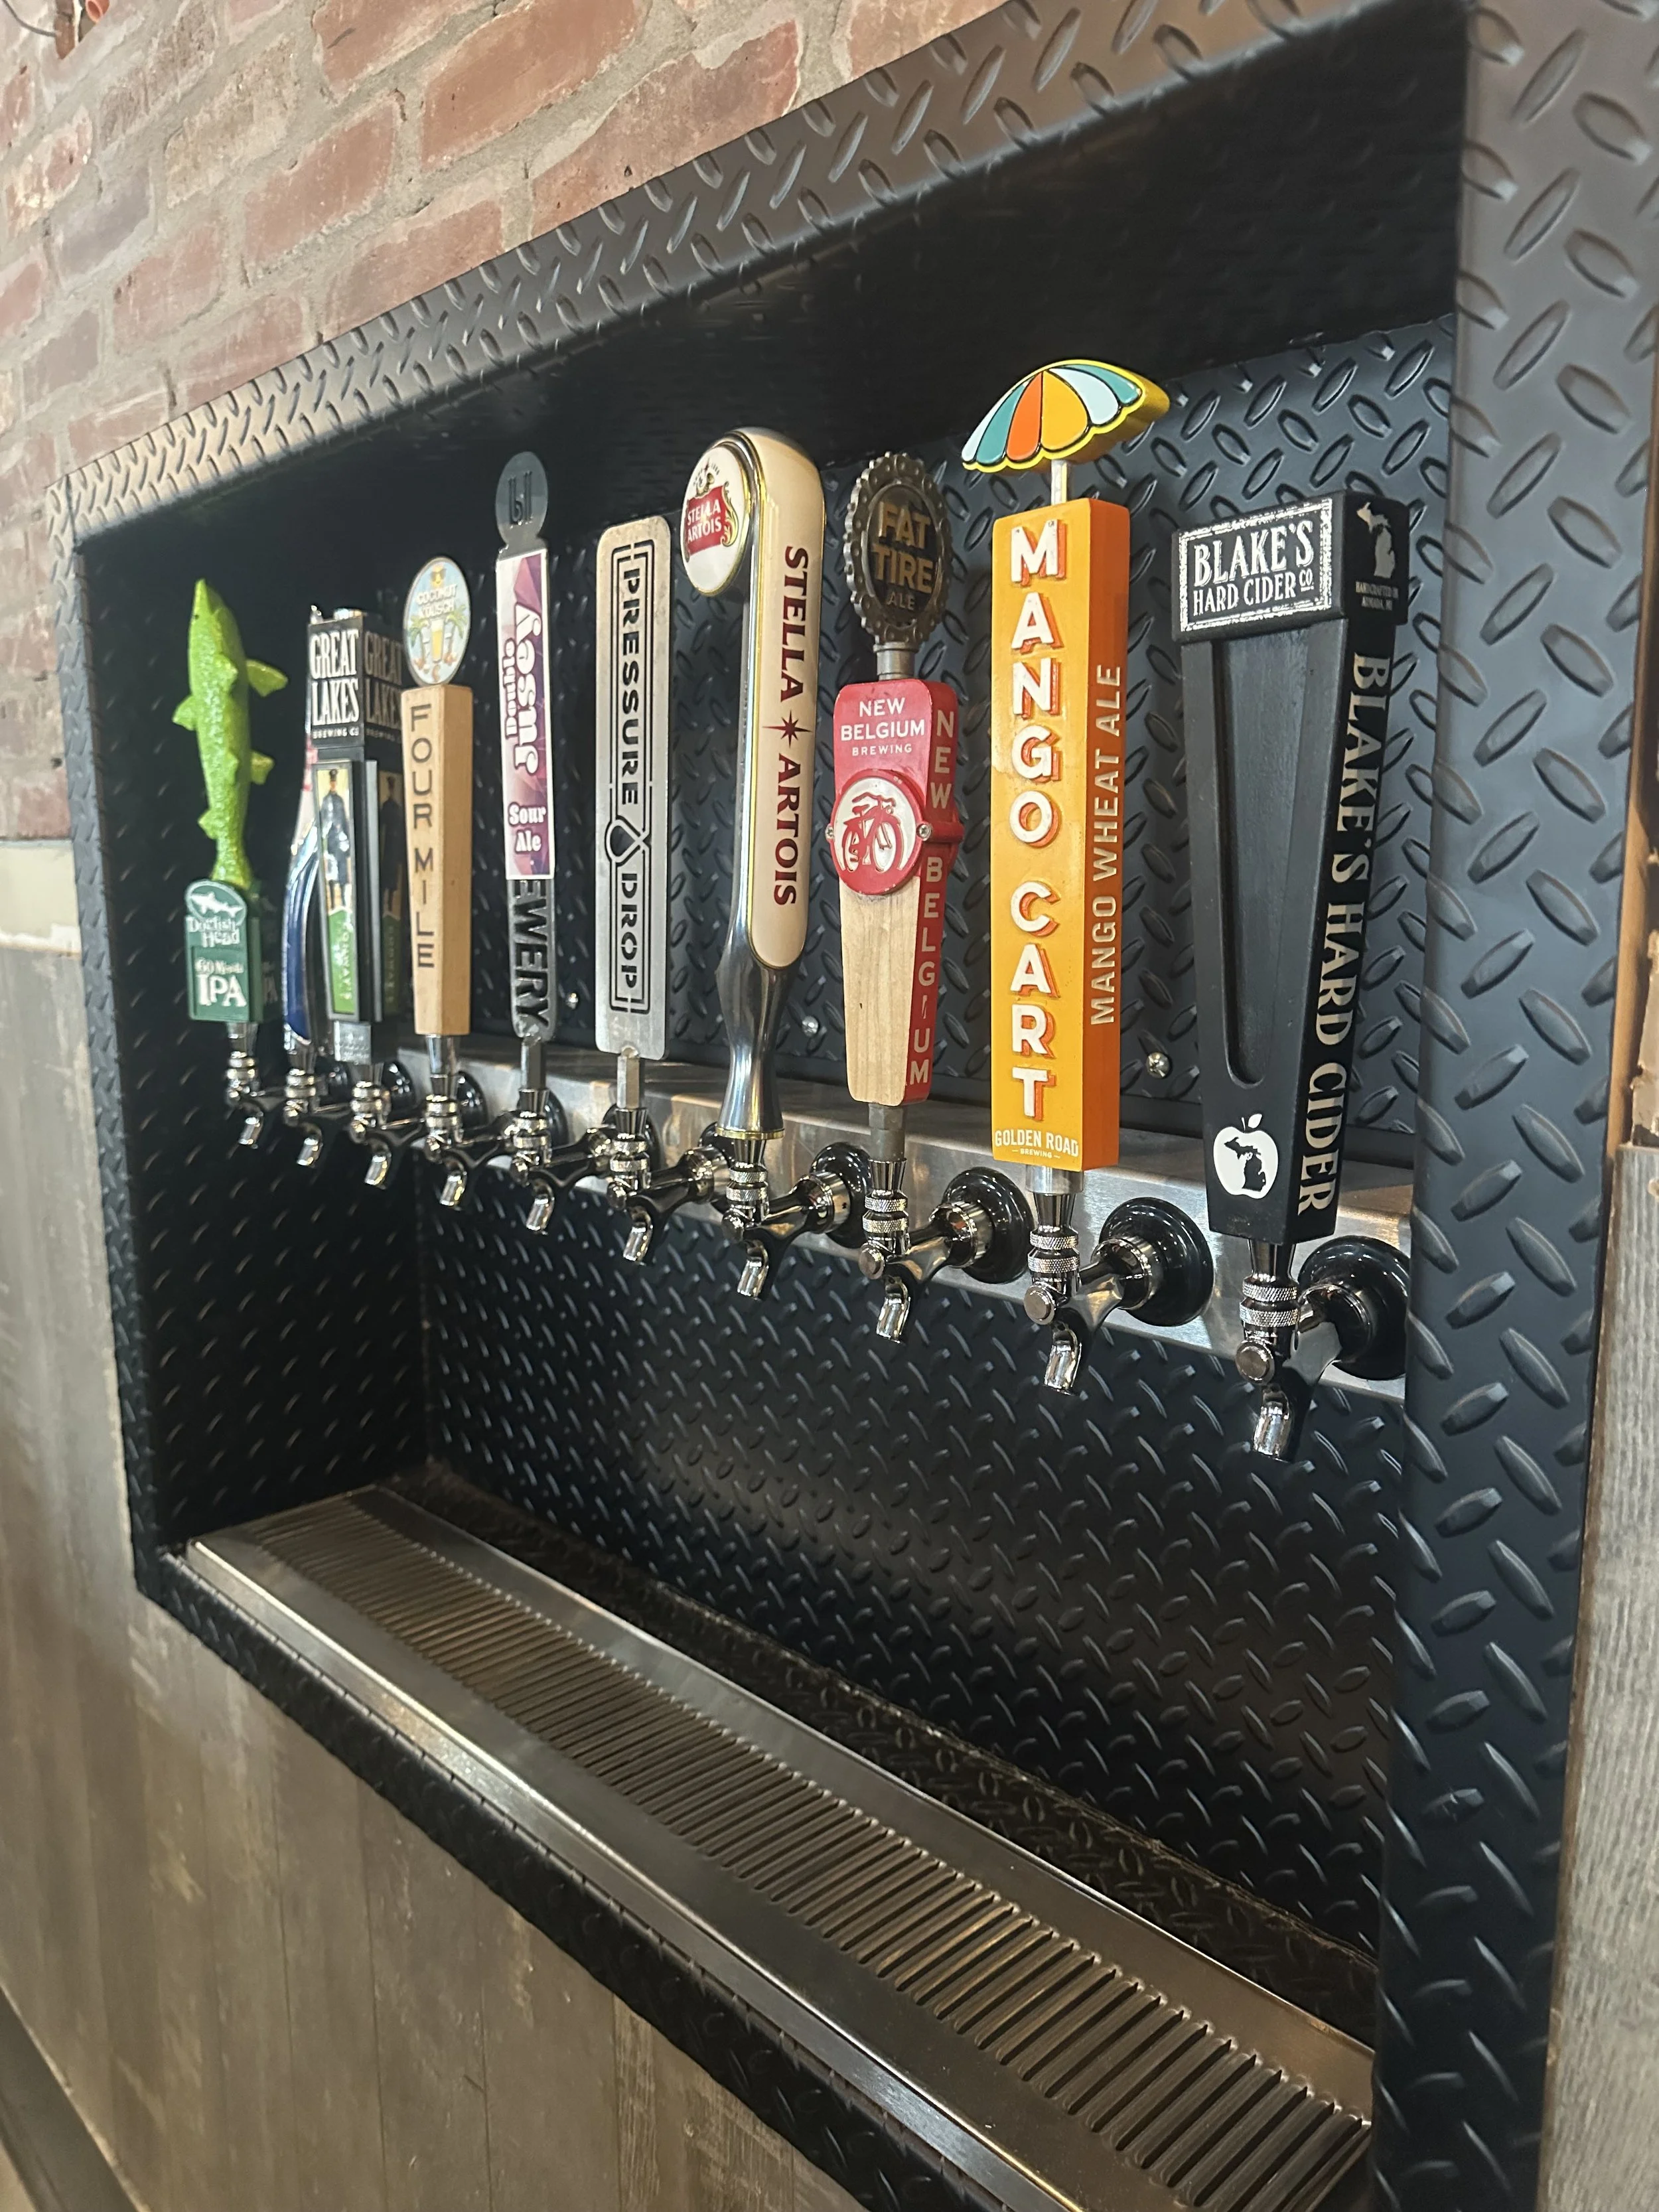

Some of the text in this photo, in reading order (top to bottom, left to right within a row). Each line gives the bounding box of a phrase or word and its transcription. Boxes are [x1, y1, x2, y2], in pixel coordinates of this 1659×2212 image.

[687, 499, 721, 526] STELLA
[687, 517, 722, 544] ARTOIS
[879, 501, 930, 550] FAT
[871, 544, 934, 594] TIRE
[1194, 520, 1315, 587] BLAKE'S
[886, 591, 916, 611] ALE
[1193, 582, 1240, 617] HARD
[1243, 570, 1296, 606] CIDER
[311, 628, 359, 679] GREAT
[366, 631, 402, 686] GREAT
[312, 678, 360, 725] LAKES
[503, 638, 517, 739] Double
[514, 602, 542, 774] Jusey
[859, 698, 906, 717] NEW
[774, 546, 809, 906] STELLA ARTOIS
[841, 719, 925, 741] BELGIUM
[852, 743, 912, 757] BREWING
[621, 568, 640, 988] PRESSURE DROP
[410, 703, 435, 968] FOUR MILE
[508, 803, 547, 825] Sour
[1010, 521, 1066, 1120] MANGO CART
[515, 831, 542, 853] Ale
[1091, 664, 1121, 1025] MANGO WHEAT ALE
[910, 709, 954, 1085] NEW BELGIUM
[202, 928, 240, 948] Head
[1297, 652, 1391, 1216] BLAKE'S HARD CIDER
[197, 975, 247, 1007] IPA
[995, 1129, 1079, 1157] GOLDEN ROAD
[1020, 1148, 1052, 1158] BREWING
